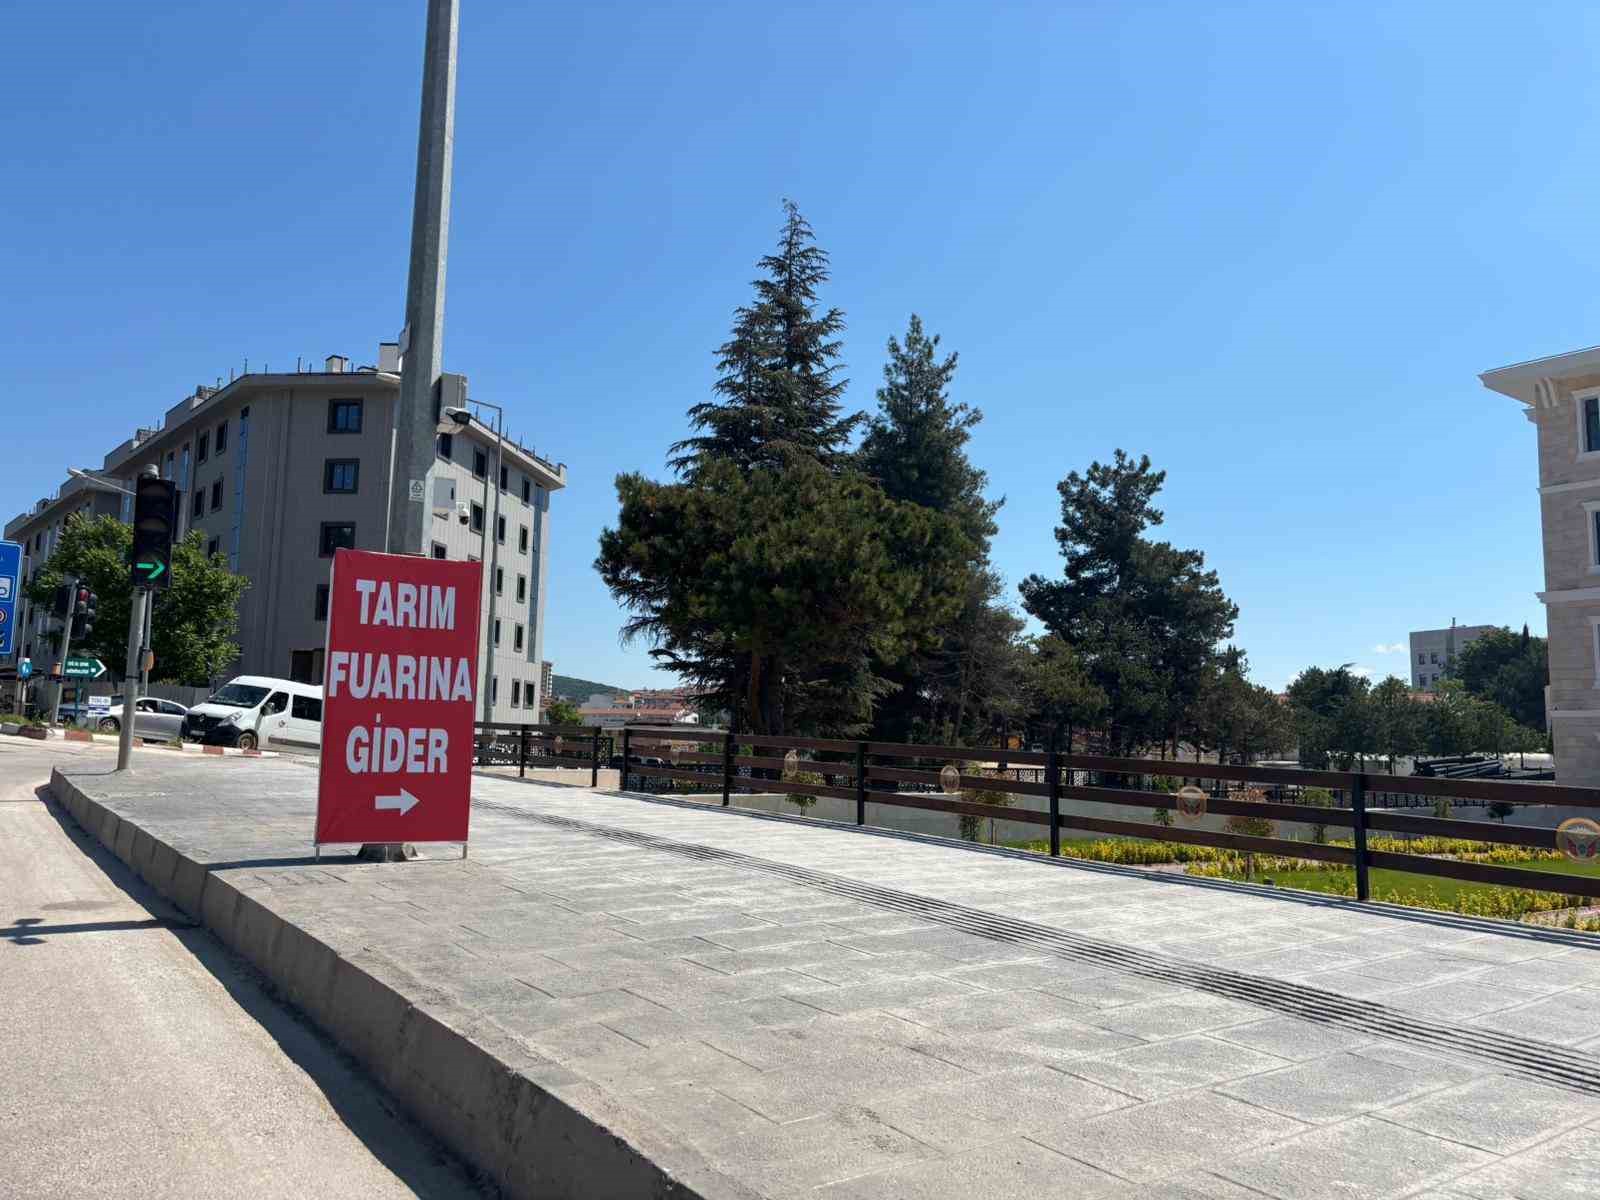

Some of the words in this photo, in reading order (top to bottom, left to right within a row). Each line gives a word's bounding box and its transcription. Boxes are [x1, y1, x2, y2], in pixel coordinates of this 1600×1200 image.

[355, 579, 456, 630] TARIM
[328, 651, 473, 702] FUARINA
[345, 713, 449, 774] GİDER
